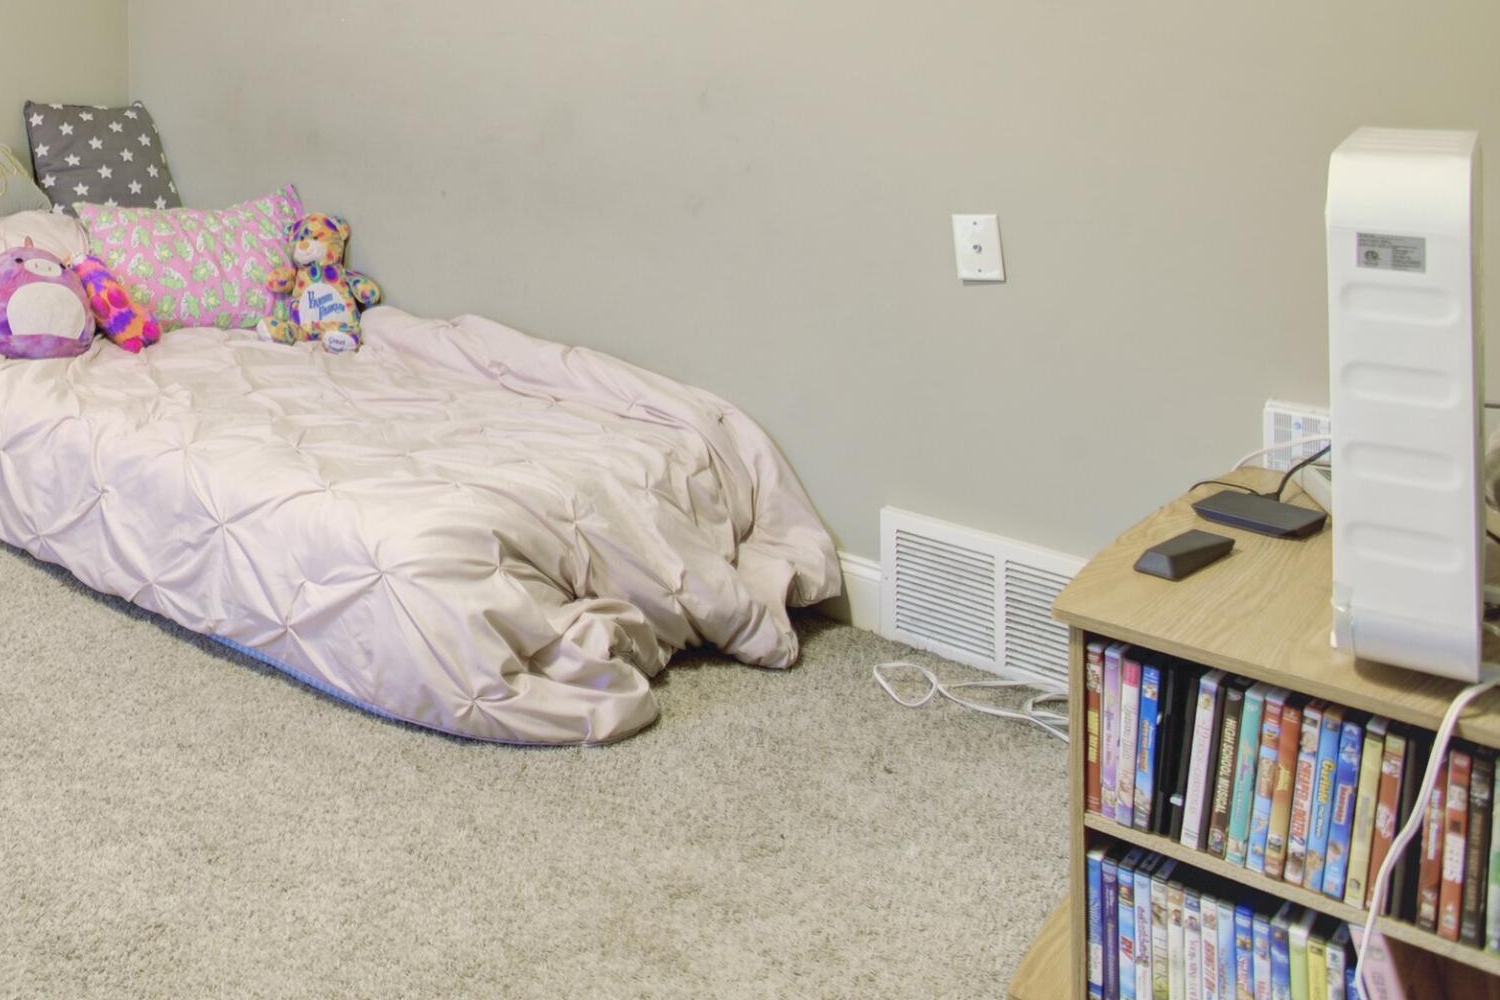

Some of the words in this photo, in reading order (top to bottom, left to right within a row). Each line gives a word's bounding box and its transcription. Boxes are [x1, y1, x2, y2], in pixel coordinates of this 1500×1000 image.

[1222, 717, 1237, 743] HIGH
[1219, 742, 1234, 777] SCHOOL
[1215, 776, 1230, 813] MUSICAL
